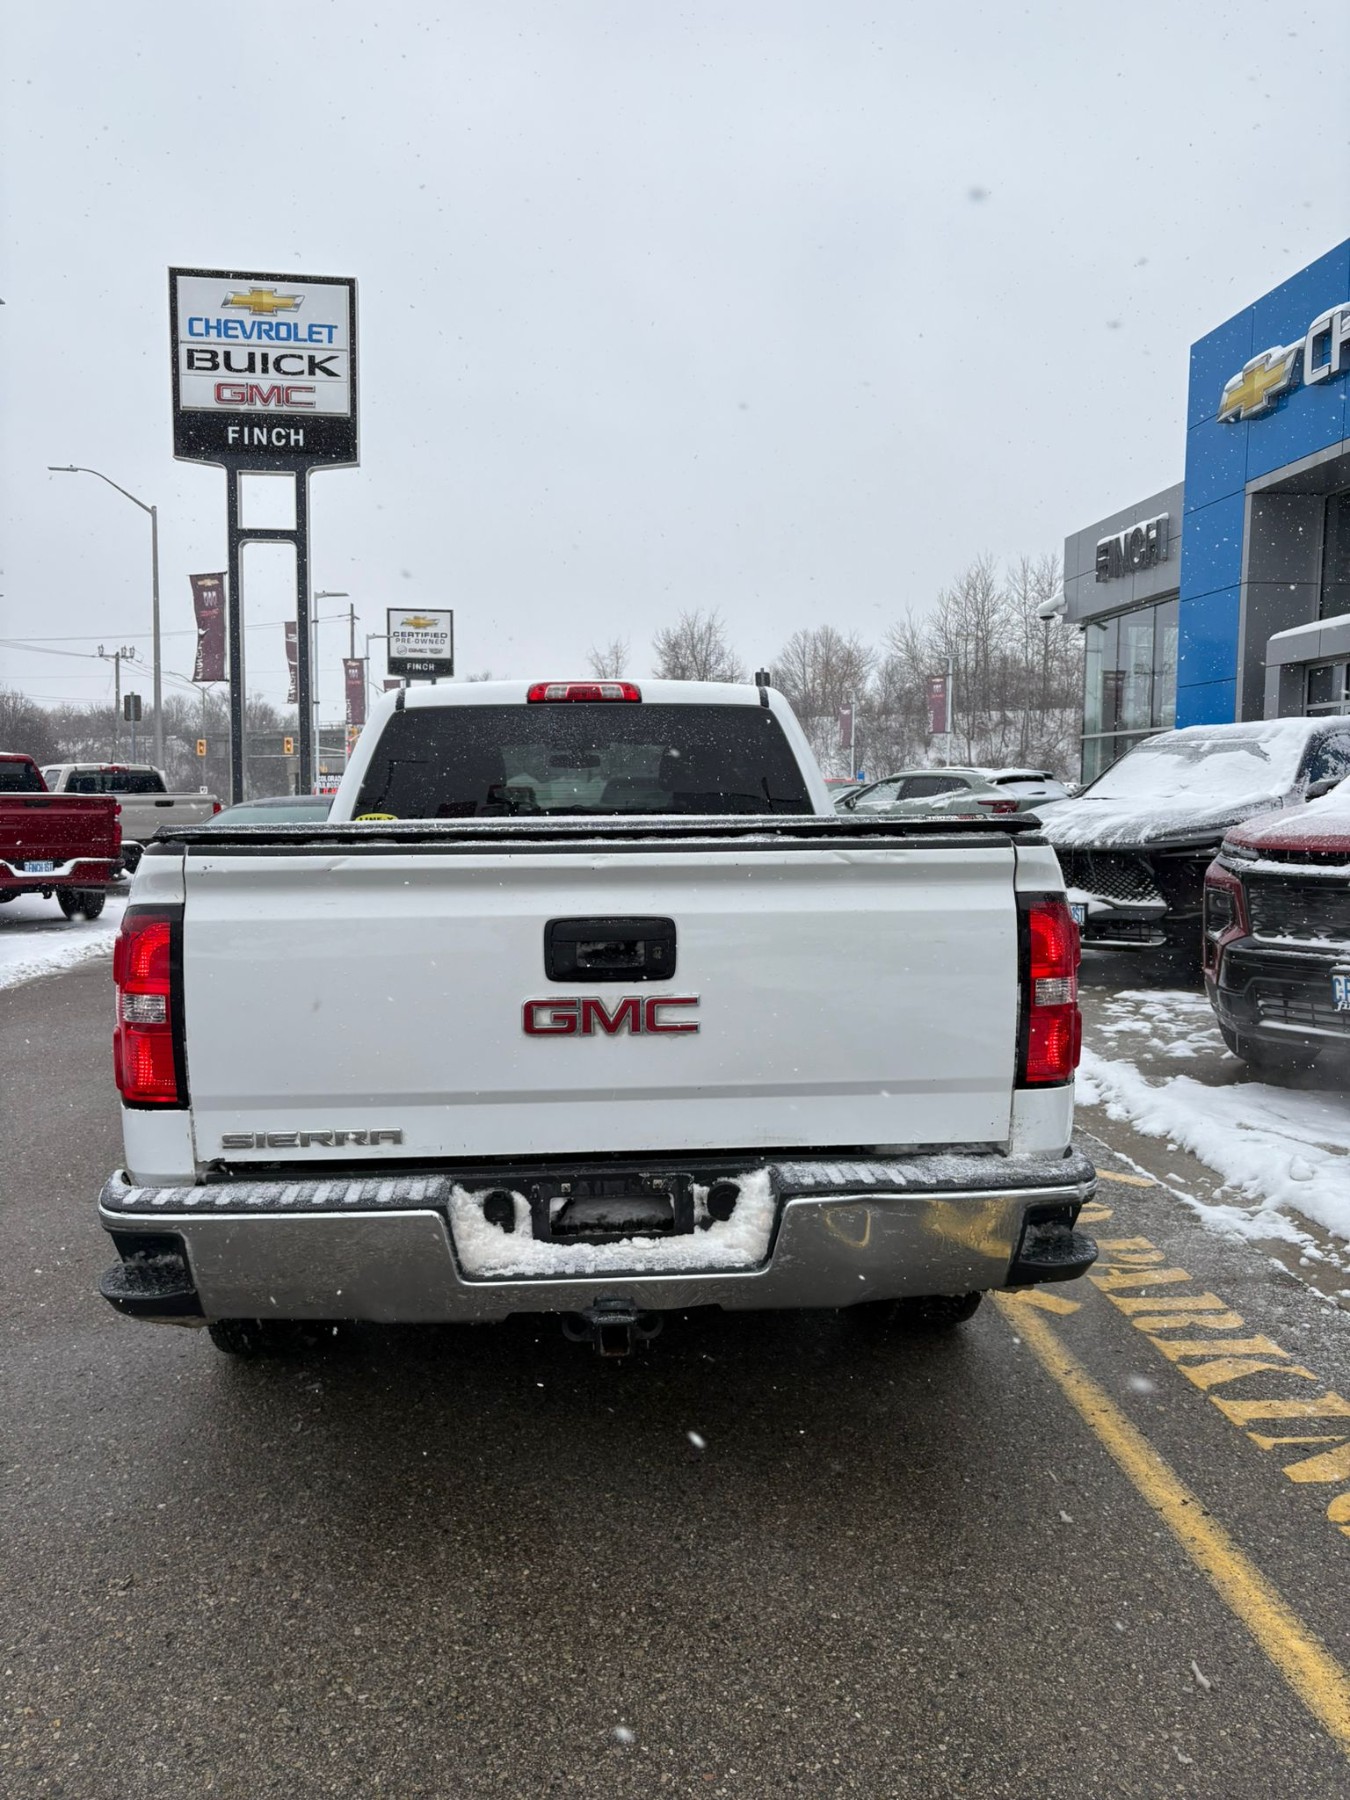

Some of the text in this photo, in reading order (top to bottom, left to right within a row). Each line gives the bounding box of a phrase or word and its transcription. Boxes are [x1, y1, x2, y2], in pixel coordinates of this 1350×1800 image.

[188, 317, 338, 344] CHEVROLET
[186, 348, 341, 377] BUICK
[214, 382, 316, 408] GMC
[228, 426, 304, 446] FINCH
[1096, 517, 1168, 583] FINCH
[406, 663, 435, 671] FINCH
[522, 995, 700, 1036] GMC
[222, 1127, 403, 1149] SIERRA
